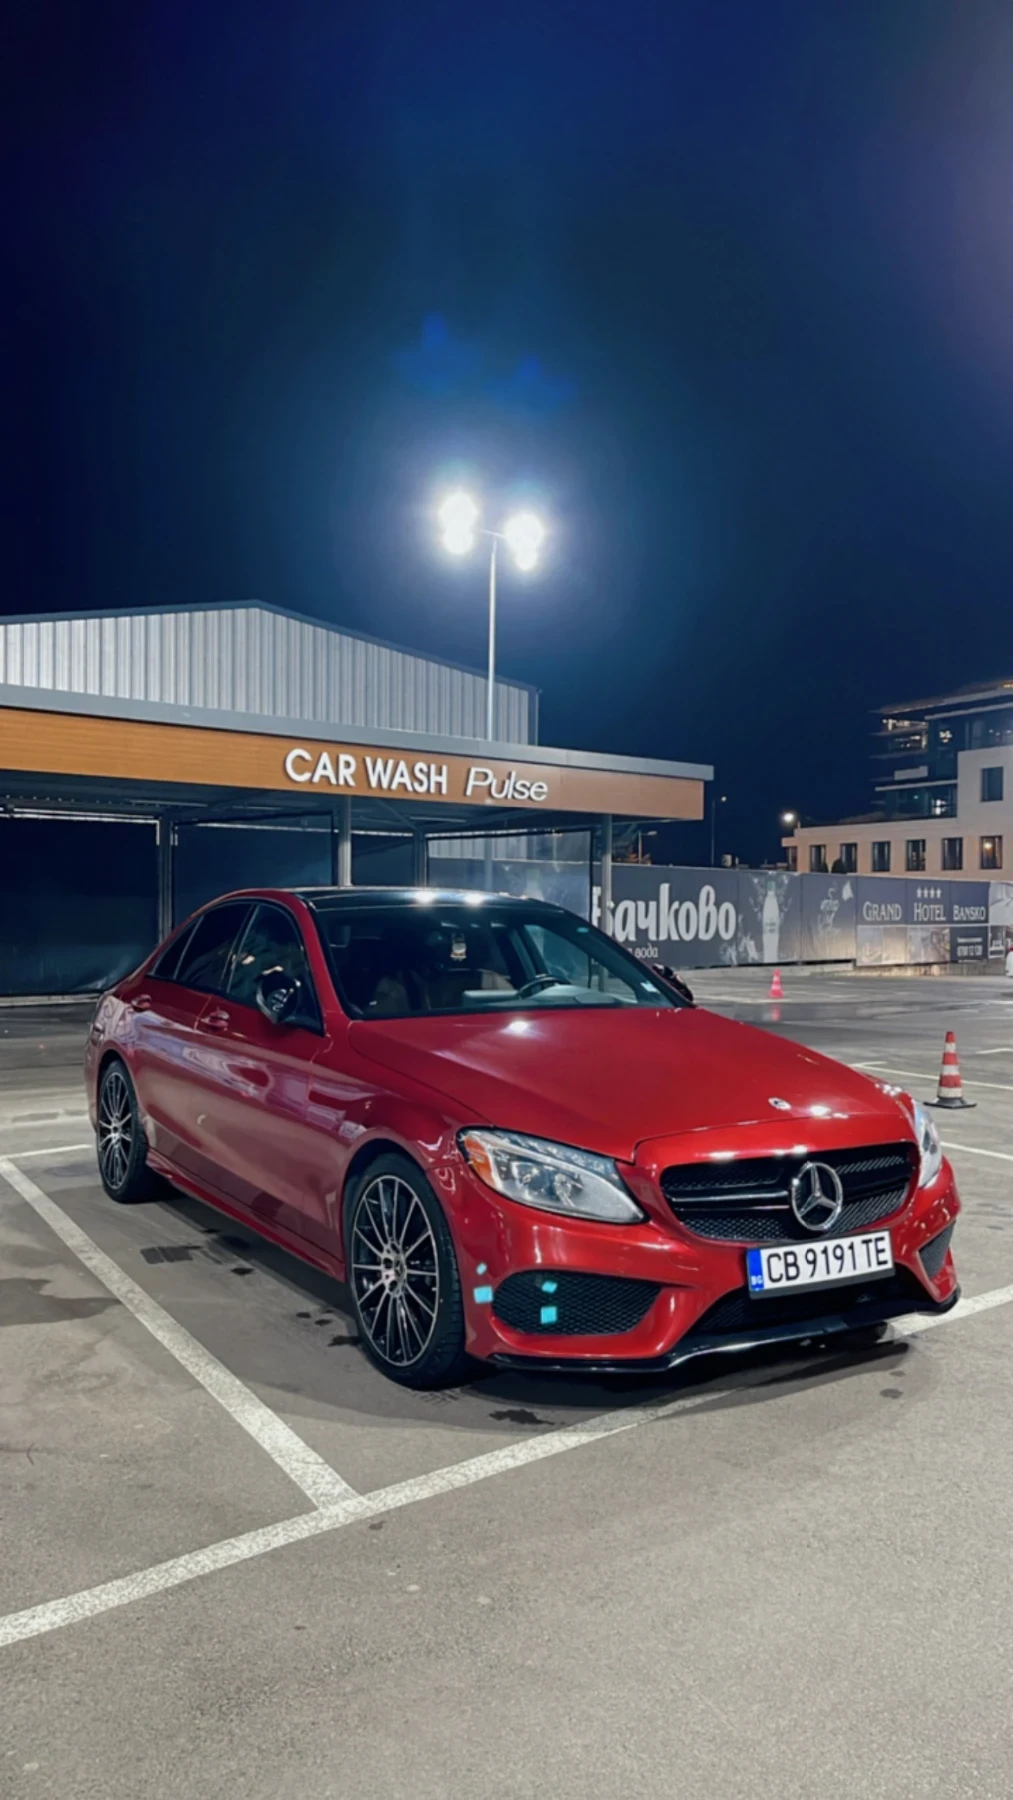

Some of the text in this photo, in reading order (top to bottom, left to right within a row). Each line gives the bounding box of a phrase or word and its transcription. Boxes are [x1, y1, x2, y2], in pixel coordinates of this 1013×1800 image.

[284, 748, 549, 801] CAR WASH Pulse
[863, 901, 986, 922] GRAND HOTEL BANSKO
